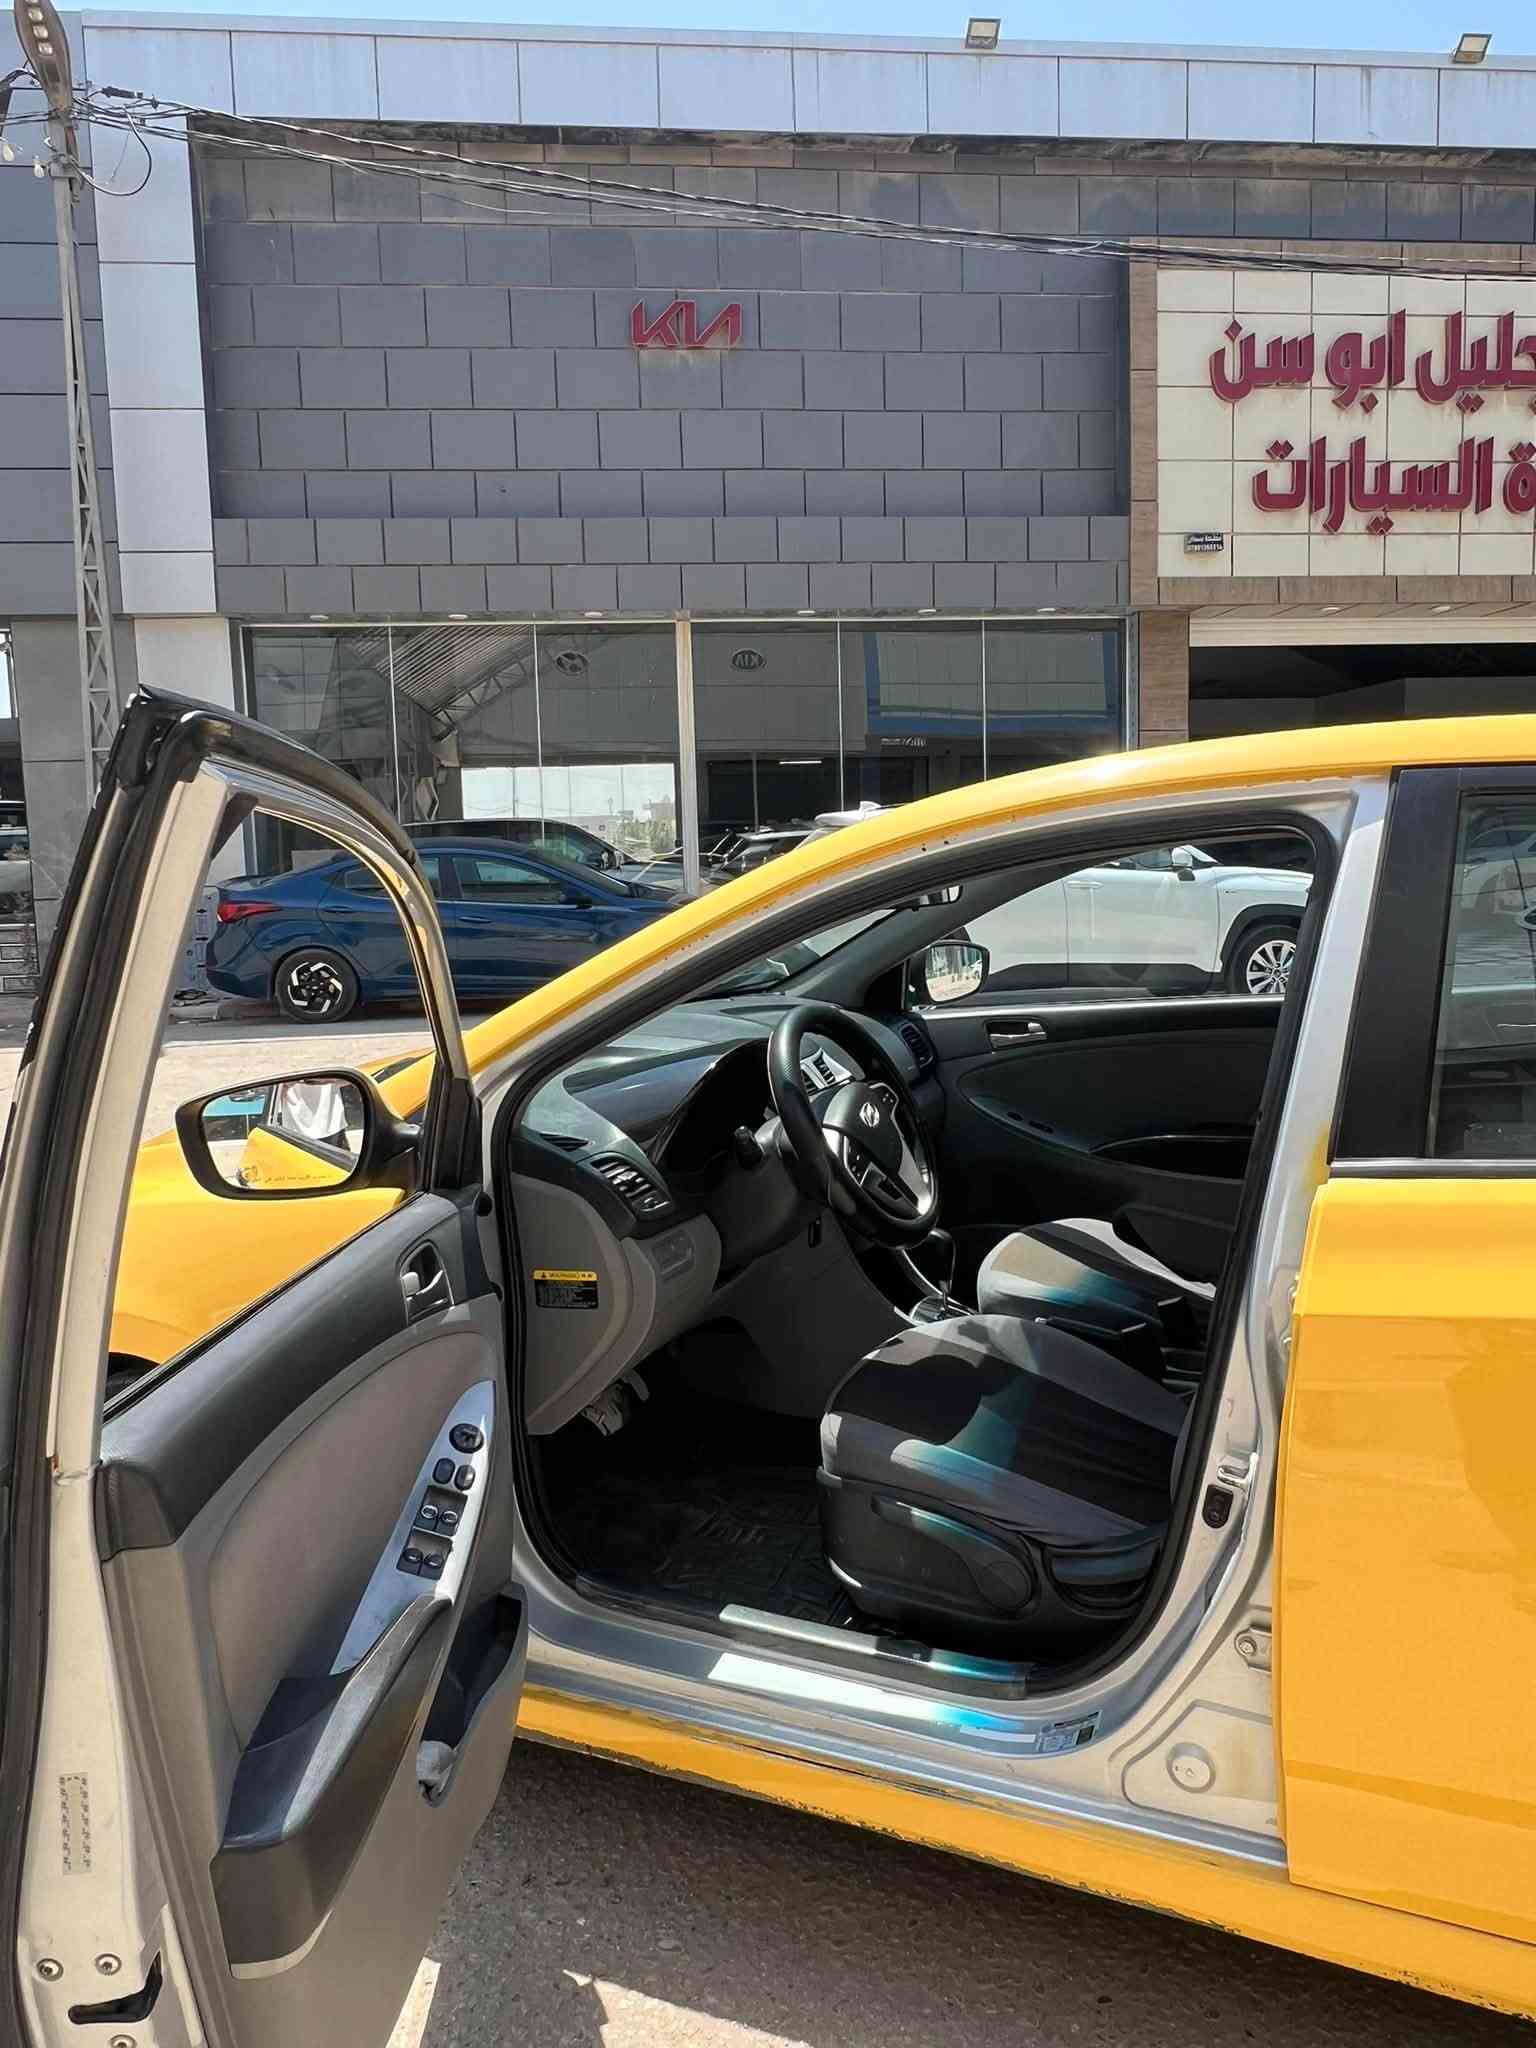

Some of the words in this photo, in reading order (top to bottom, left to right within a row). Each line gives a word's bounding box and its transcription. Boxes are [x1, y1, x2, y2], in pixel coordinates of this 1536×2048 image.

[631, 299, 743, 348] KIA
[1209, 320, 1315, 403] سن
[1326, 308, 1406, 414] ابو
[1252, 436, 1494, 536] السيارات
